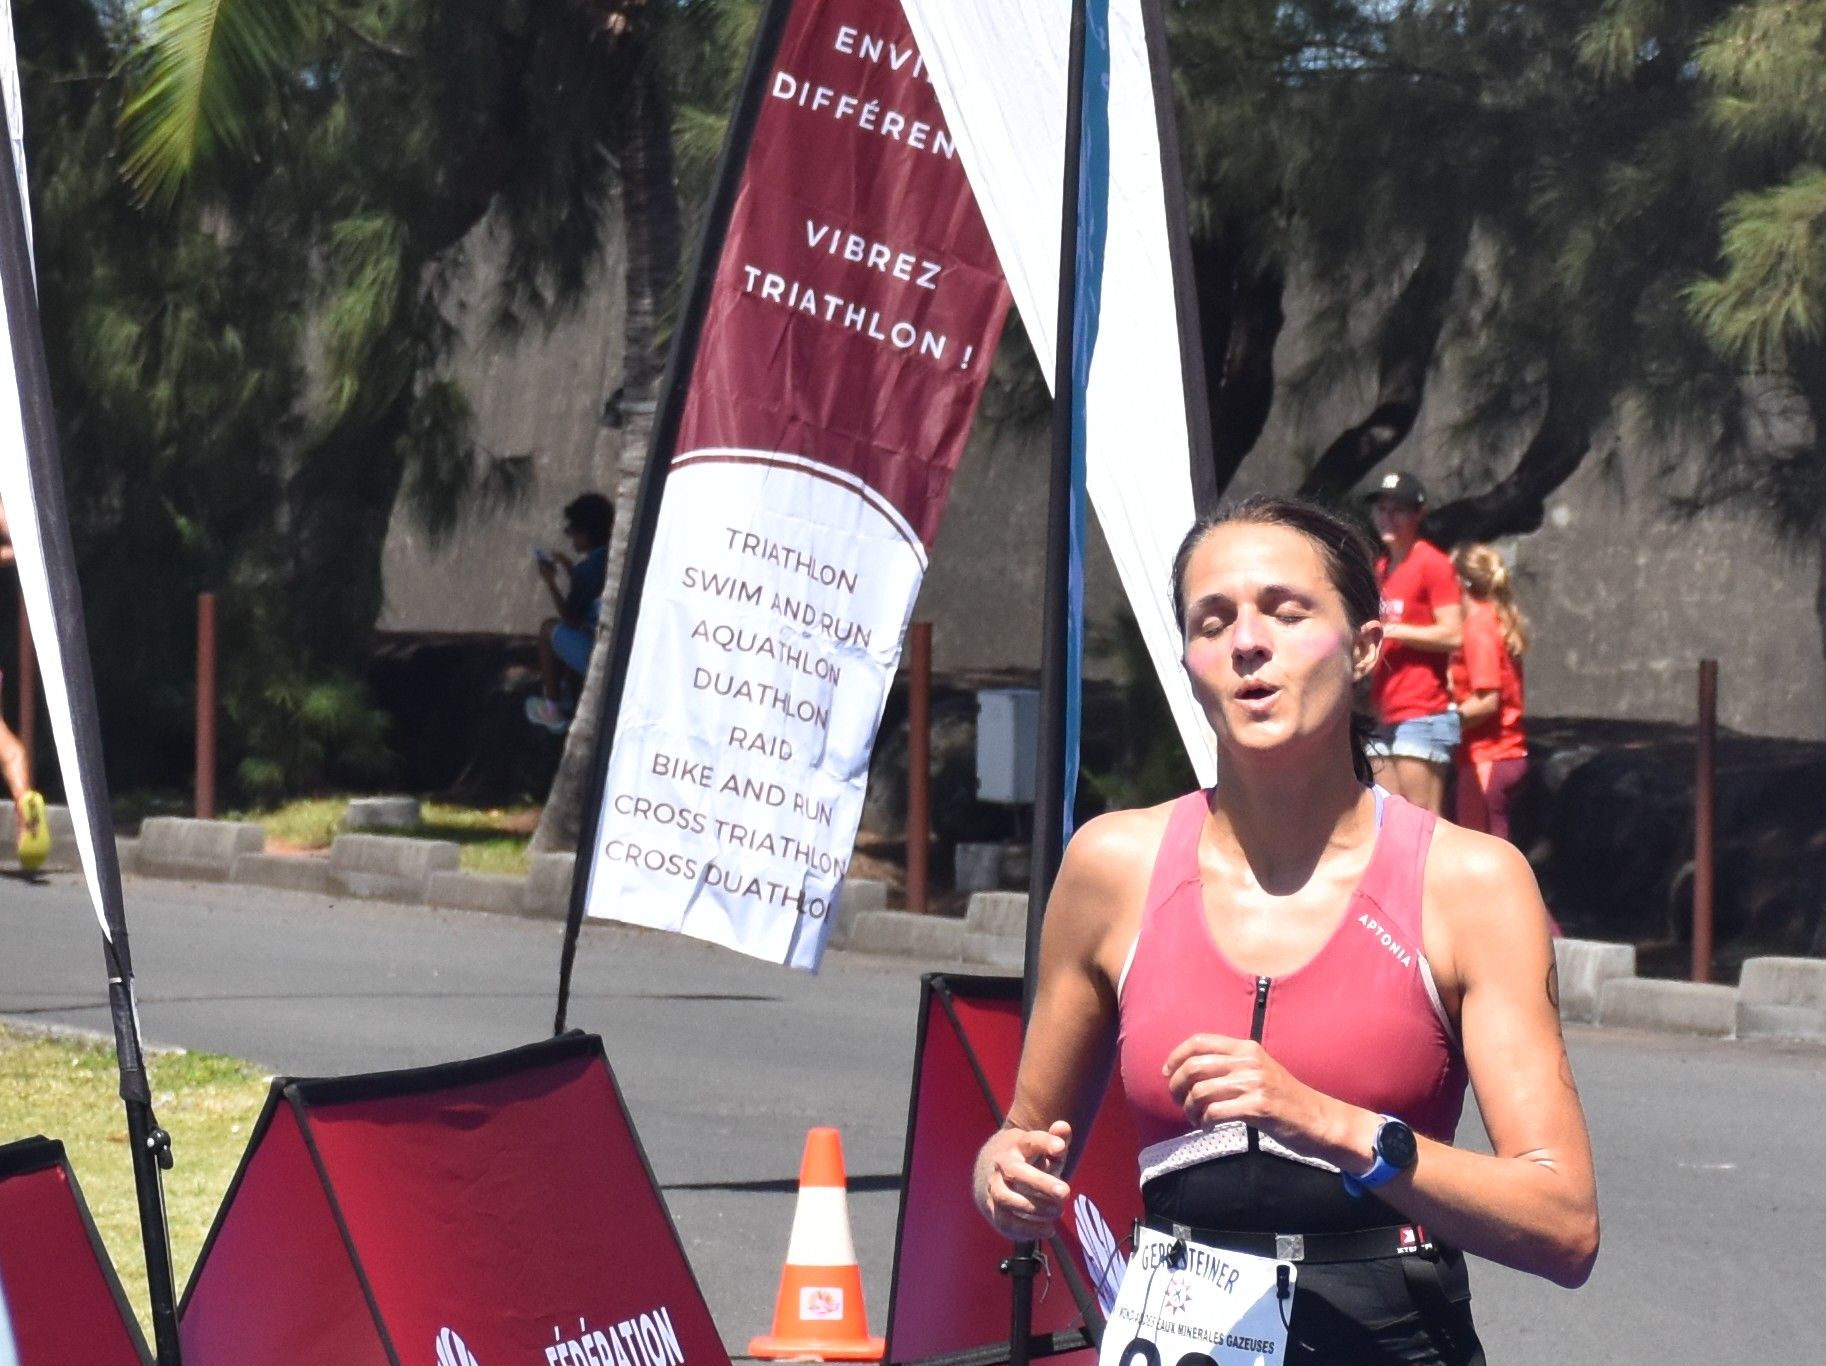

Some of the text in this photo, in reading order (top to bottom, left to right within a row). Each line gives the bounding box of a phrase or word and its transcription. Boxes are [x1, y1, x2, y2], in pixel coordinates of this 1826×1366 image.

[834, 26, 932, 84] ENVI
[806, 220, 942, 290] VIBREZ
[744, 265, 973, 369] TRIATHLON !
[725, 527, 859, 594] TRIATHLON
[681, 566, 873, 648] SWIM AND RUN
[691, 619, 842, 687] AQUATHLON
[692, 667, 829, 730] DUATHLON
[728, 726, 793, 761] RAID
[652, 753, 833, 828] BIKE AND RUN
[605, 839, 698, 880] CROSS
[614, 794, 846, 878] CROSS TRIATHLON
[1357, 913, 1411, 967] APTONIA
[1225, 1334, 1276, 1355] GAZEUSES
